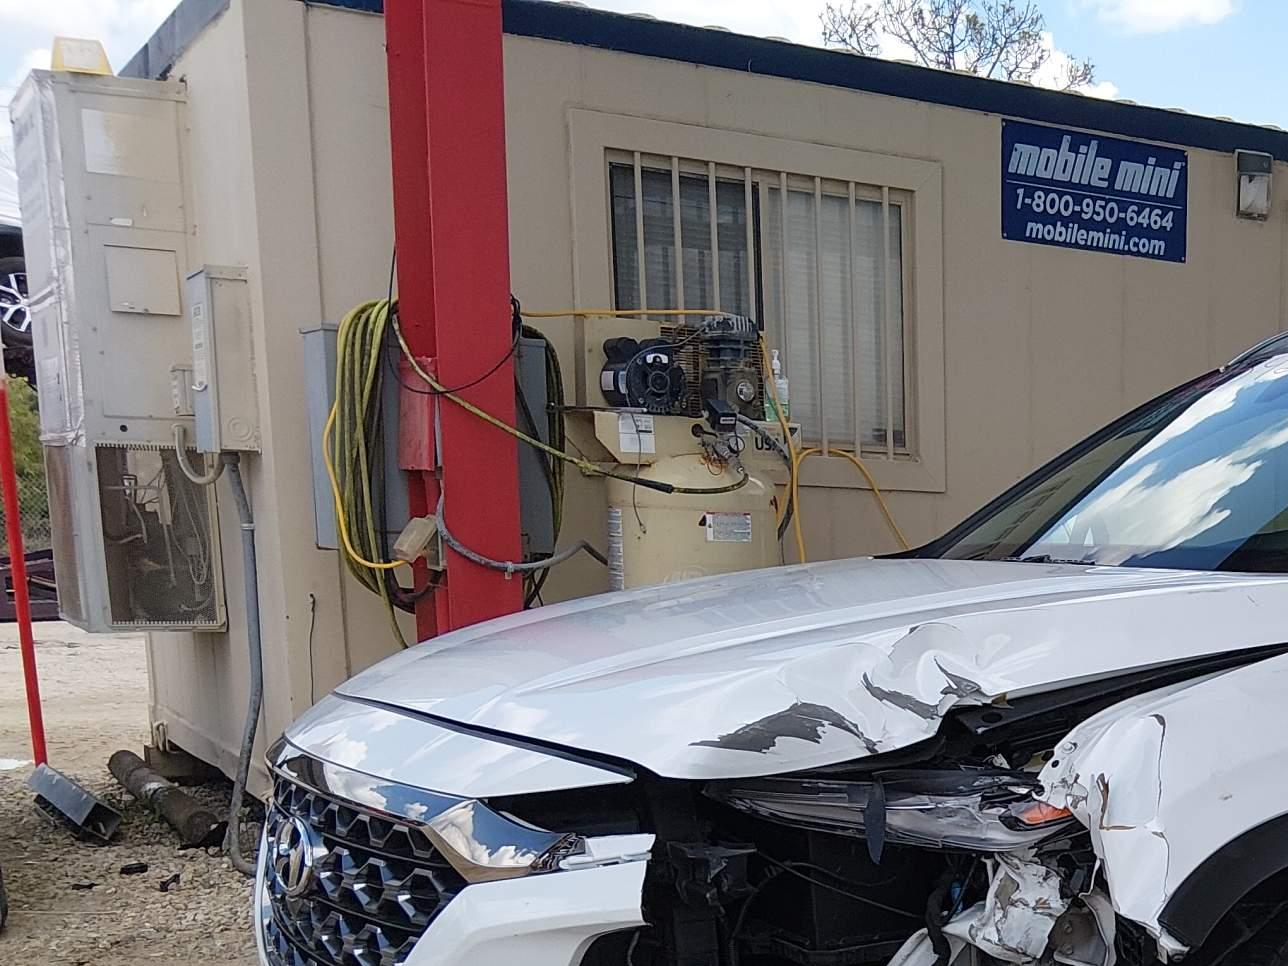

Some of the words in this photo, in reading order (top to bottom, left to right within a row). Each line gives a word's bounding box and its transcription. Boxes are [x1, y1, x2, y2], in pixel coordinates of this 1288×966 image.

[1007, 135, 1112, 188] mobile
[1114, 157, 1182, 199] mini
[1016, 188, 1174, 231] 1-800-950-6464
[1025, 221, 1166, 255] mobilemini.com
